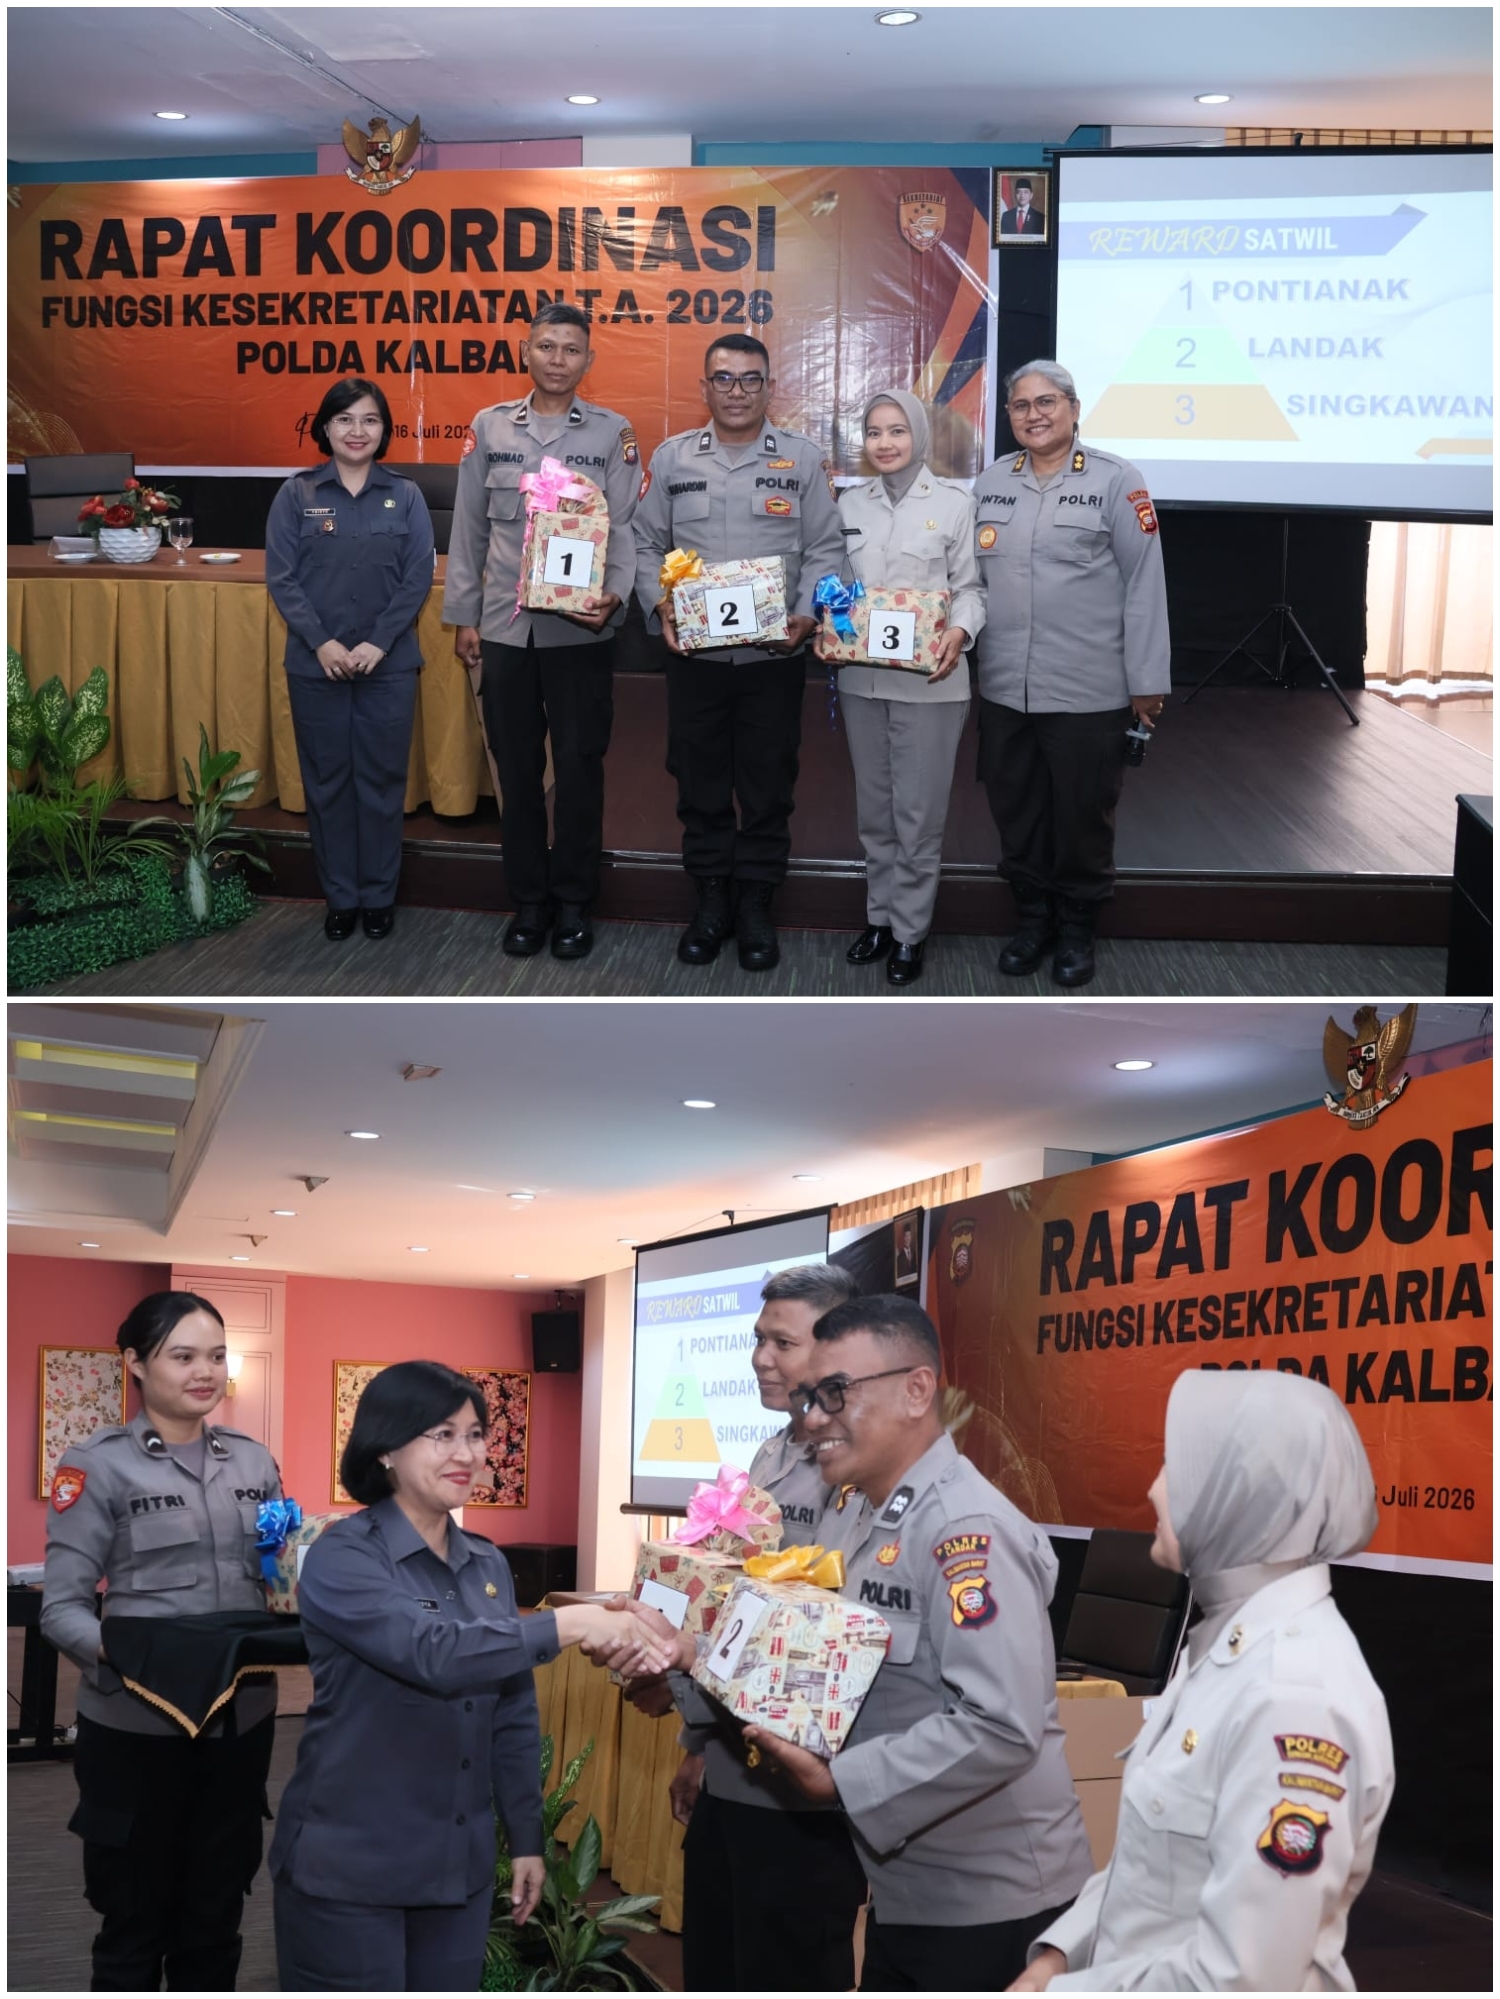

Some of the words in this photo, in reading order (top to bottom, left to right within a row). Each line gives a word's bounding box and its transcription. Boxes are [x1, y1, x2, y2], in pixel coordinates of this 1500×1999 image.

[40, 214, 277, 280] RAPAT
[296, 205, 776, 275] KOORDINASI
[1088, 225, 1240, 257] REWARD
[1244, 226, 1338, 252] SATWIL
[42, 295, 173, 328] FUNGSI
[575, 289, 654, 324] T.A.
[667, 289, 774, 325] 2026
[1179, 280, 1192, 311] 1
[1212, 278, 1410, 302] PONTIANAK
[237, 341, 366, 374] POLDA
[376, 340, 528, 374] KALBA
[1175, 338, 1196, 369] 2
[1248, 336, 1384, 360] LANDAK
[1174, 394, 1196, 425] 3
[1286, 394, 1493, 418] SINGKAWAN
[412, 424, 439, 438] Juli
[444, 425, 474, 439] 202
[487, 452, 524, 464] ROHMAD
[565, 454, 606, 468] POLRI
[755, 477, 799, 492] POLRI
[980, 495, 1017, 506] INTAN
[1058, 494, 1103, 507] POLRI
[560, 552, 573, 576] 1
[719, 601, 740, 627] 2
[881, 625, 900, 650] 3
[1039, 1179, 1250, 1296] RAPAT
[1265, 1123, 1493, 1263] KOOR
[646, 1295, 702, 1323] REWARD
[703, 1291, 741, 1314] SATWIL
[1037, 1303, 1145, 1355] FUNGSI
[1152, 1261, 1493, 1345] KESEKRETARIA
[677, 1339, 684, 1362] 1
[690, 1332, 757, 1355] PONTIANA
[1345, 1346, 1493, 1404] KALB
[674, 1382, 685, 1407] 2
[703, 1378, 756, 1398] LANDAK
[674, 1426, 683, 1450] 3
[716, 1424, 781, 1442] SINGKAW
[130, 1494, 186, 1515] FITRI
[1382, 1485, 1419, 1507] Juli
[1423, 1486, 1475, 1511] 2026
[936, 1535, 988, 1557] POLRES
[860, 1579, 911, 1611] POLRI
[719, 1618, 744, 1660] 2
[1283, 1736, 1345, 1766] POLRES
